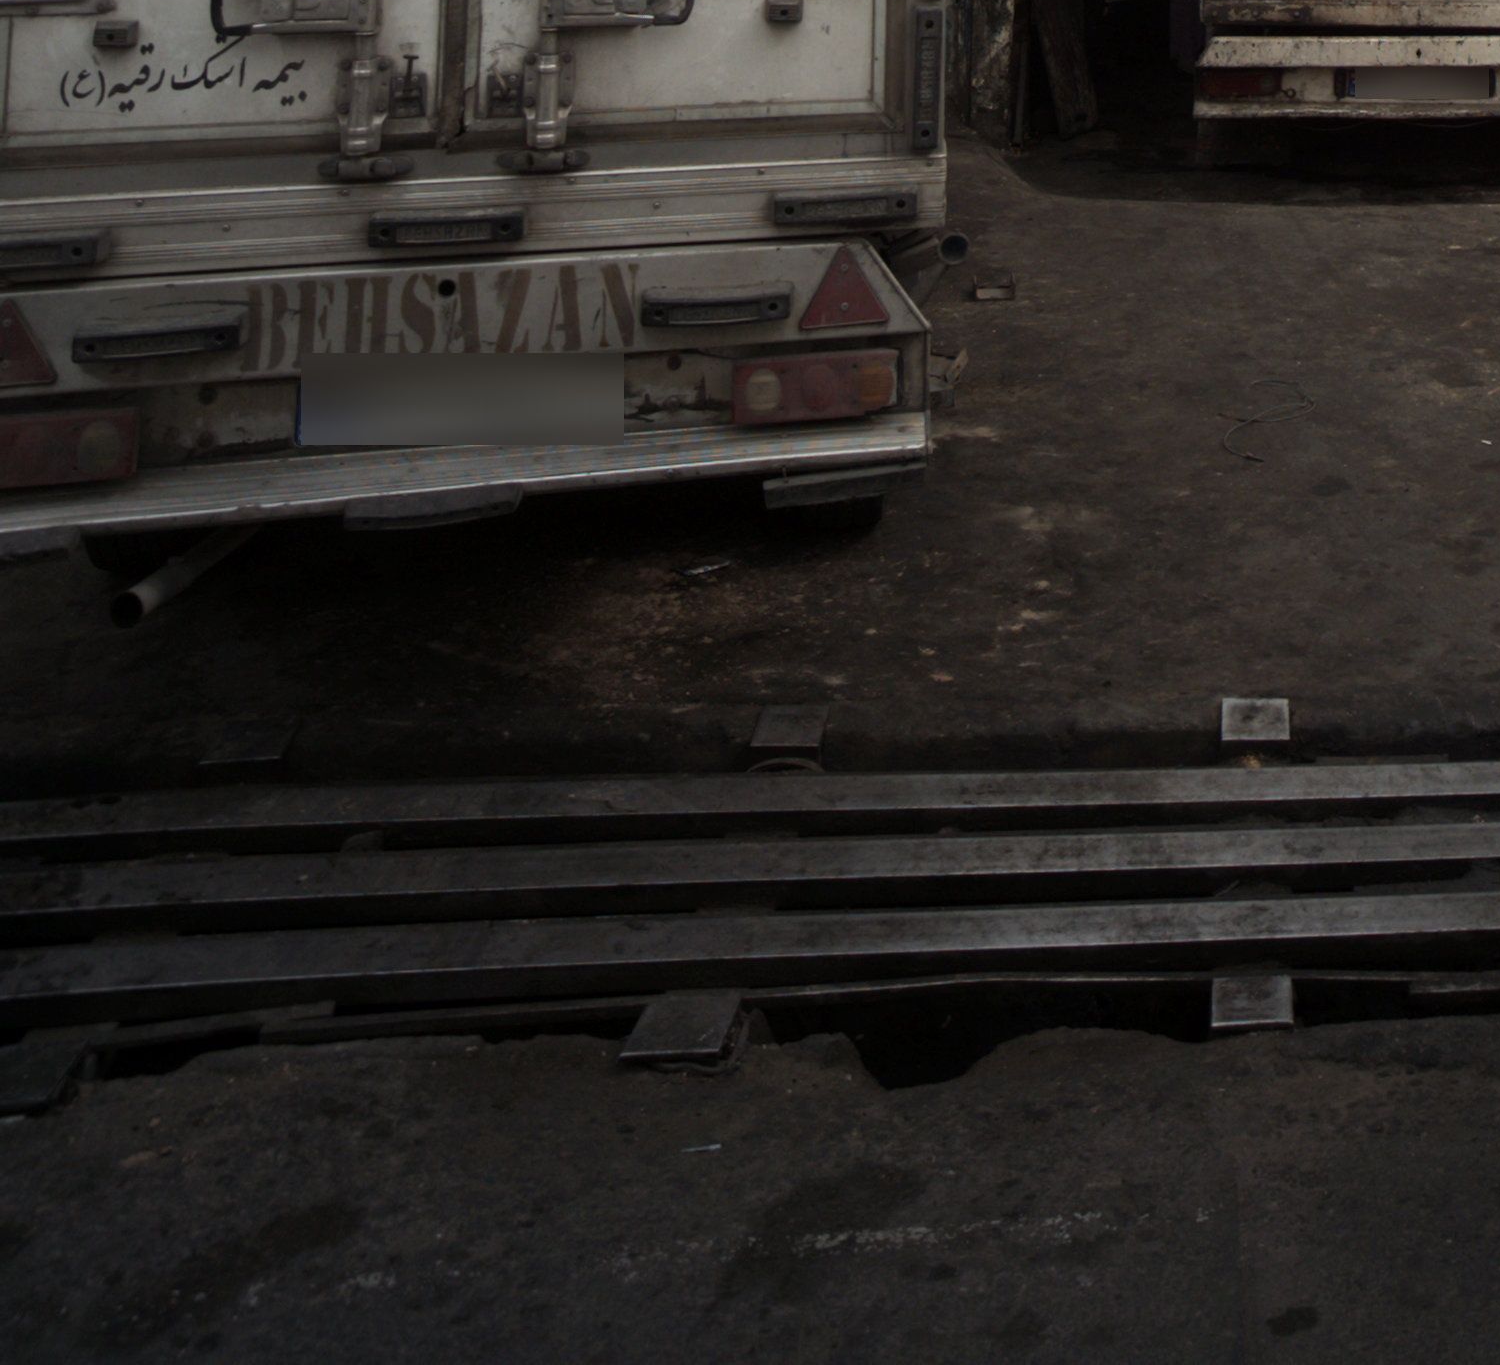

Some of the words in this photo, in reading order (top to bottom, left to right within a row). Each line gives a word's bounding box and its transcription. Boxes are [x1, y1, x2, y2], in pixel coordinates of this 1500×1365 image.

[60, 69, 106, 107] (ع)
[108, 42, 165, 112] رقیه
[252, 59, 307, 106] بیمه
[242, 263, 640, 371] BEHSAZAN
